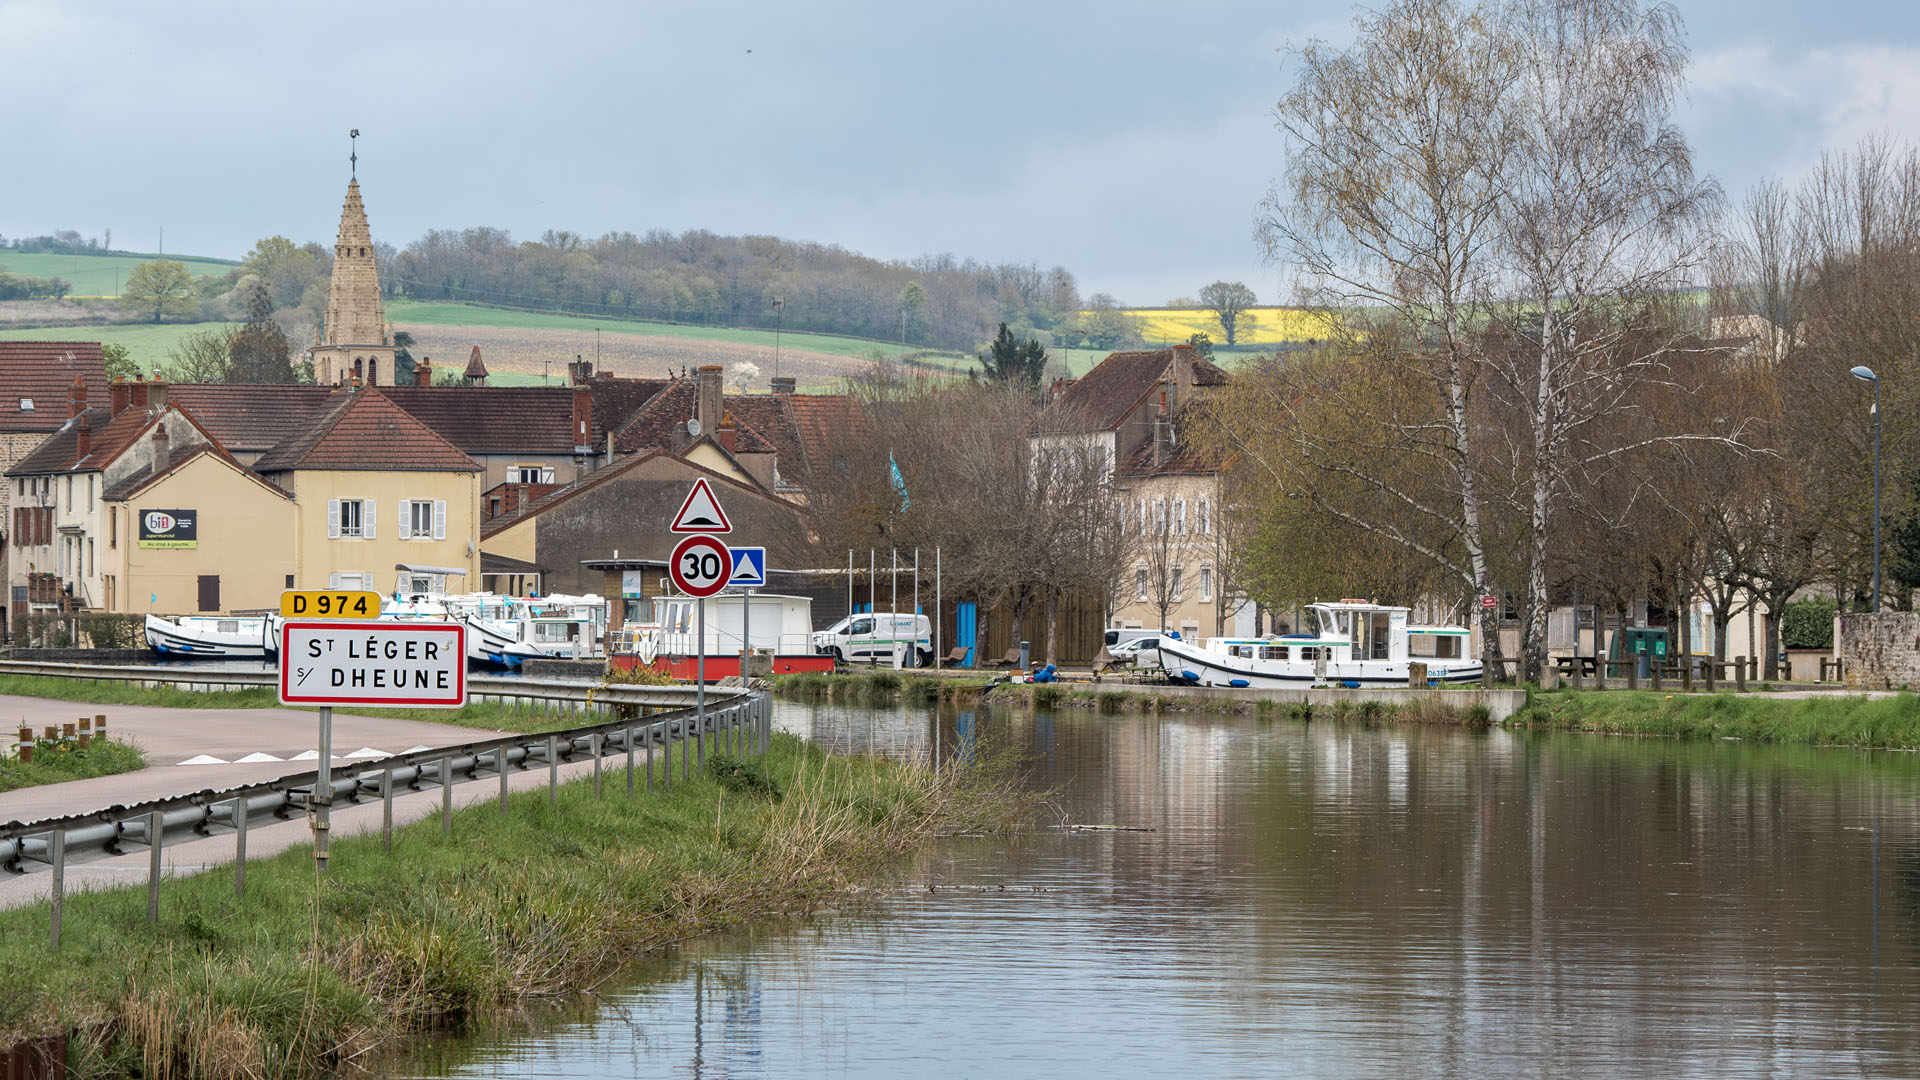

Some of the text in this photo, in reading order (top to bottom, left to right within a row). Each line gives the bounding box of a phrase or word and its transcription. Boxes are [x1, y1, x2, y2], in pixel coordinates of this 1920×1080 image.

[683, 553, 720, 580] 30
[293, 595, 367, 615] D 974
[349, 636, 438, 660] LÉGER
[331, 668, 449, 689] DHEUNE
